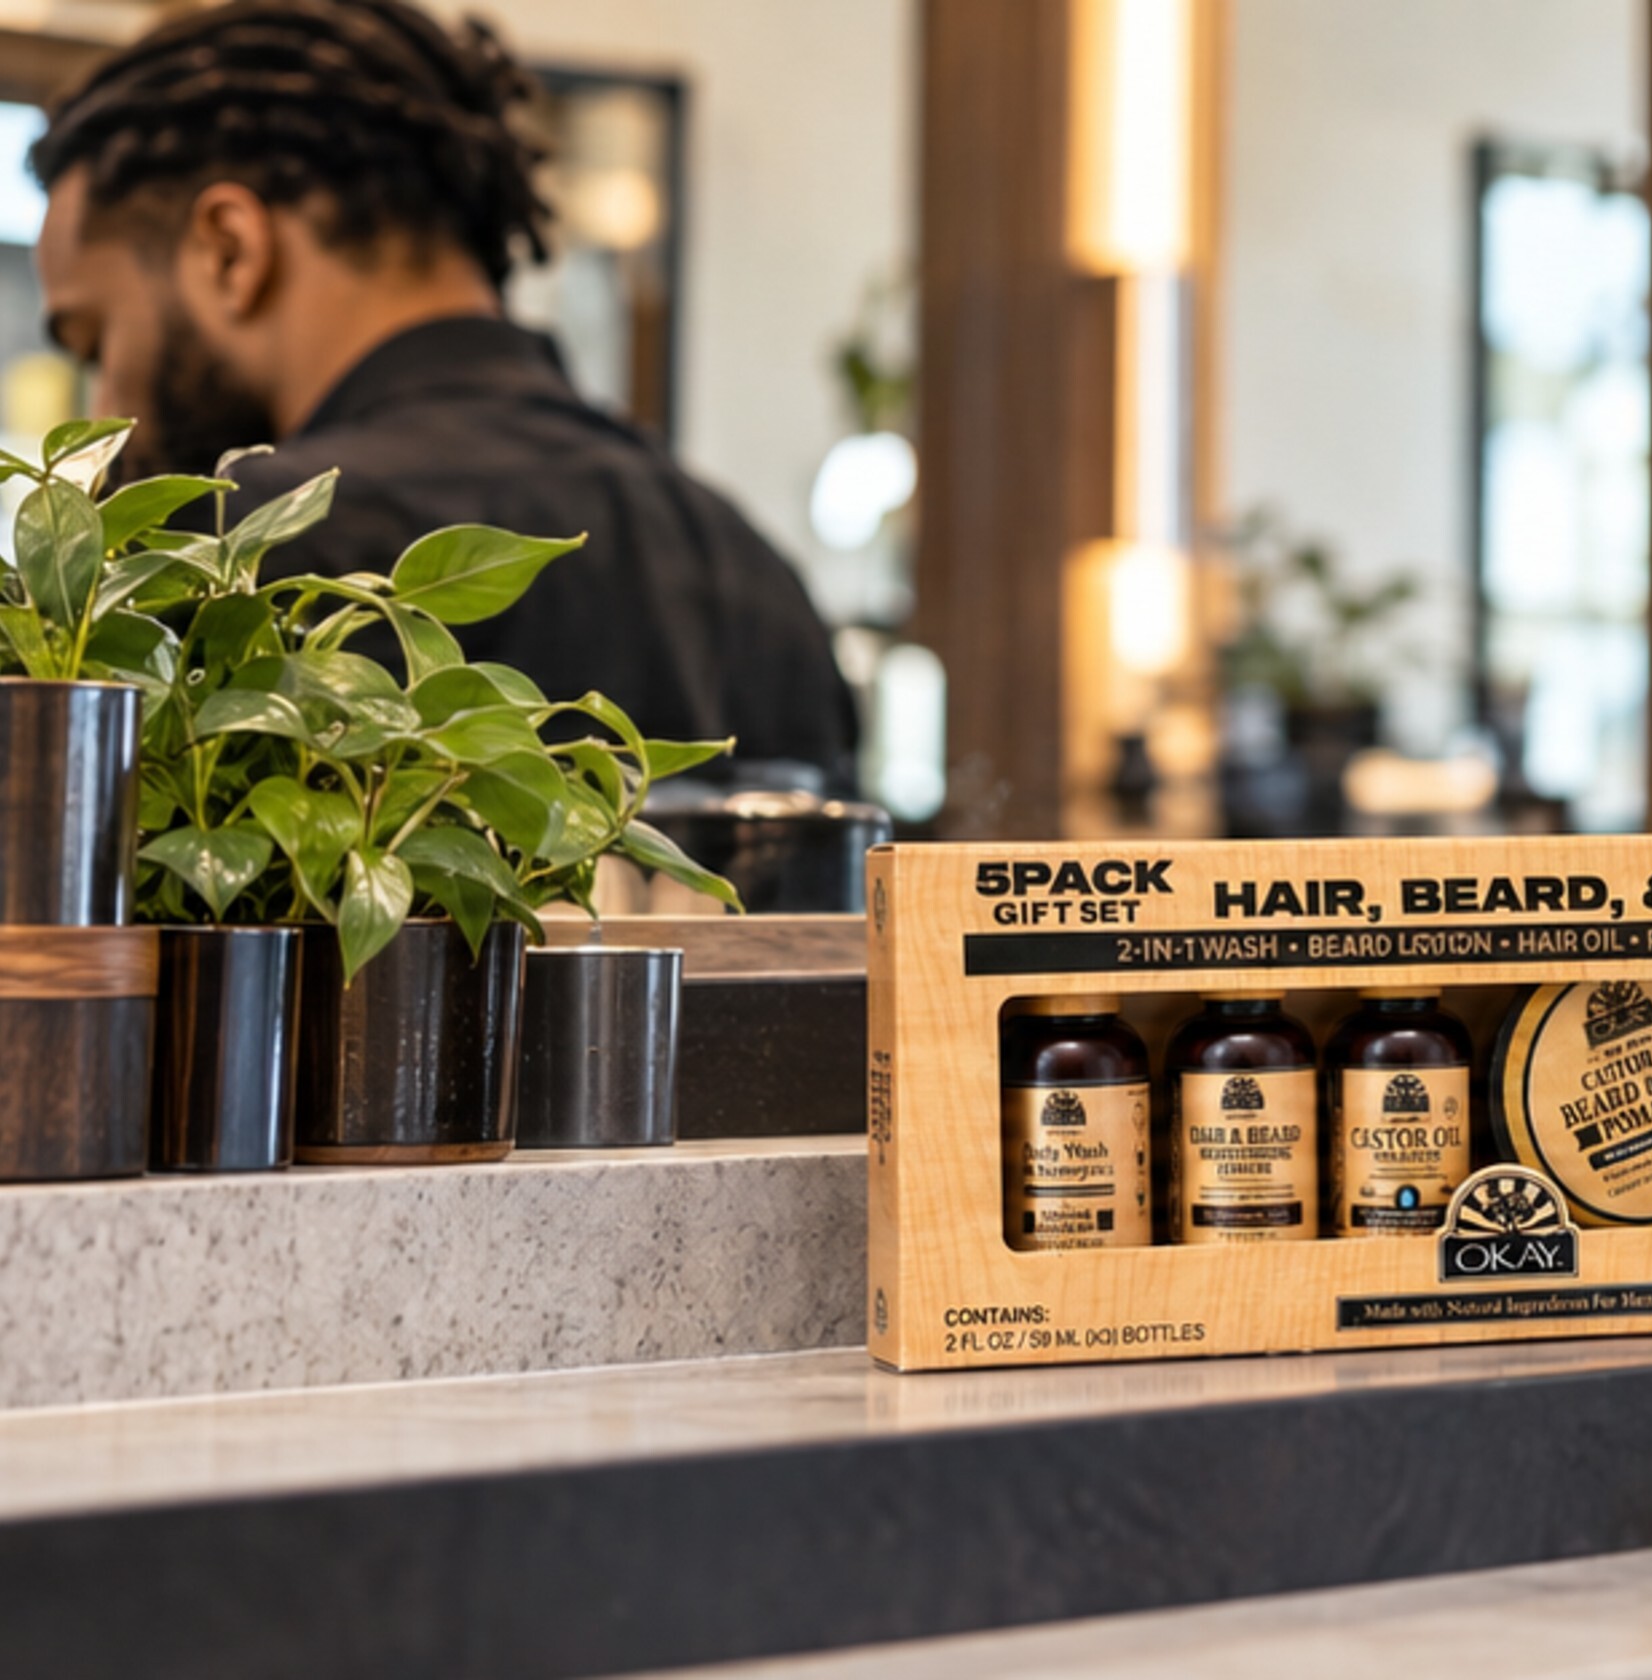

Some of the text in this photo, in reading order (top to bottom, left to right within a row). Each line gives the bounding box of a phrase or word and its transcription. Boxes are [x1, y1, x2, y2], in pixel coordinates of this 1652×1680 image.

[975, 859, 1174, 896] 5PACK
[993, 899, 1141, 926] GIFT SET
[1214, 879, 1382, 923] HAIR,
[1400, 875, 1625, 919] BEARD,
[1116, 937, 1195, 963] 2-IN-1
[1199, 935, 1279, 960] WASH
[1307, 934, 1392, 959] BEARD
[1517, 929, 1578, 953] HAIR
[1582, 928, 1624, 951] OIL
[1454, 1242, 1560, 1273] OKAY
[944, 1304, 1051, 1327] CONTAINS:
[944, 1332, 957, 1352] 2
[960, 1331, 984, 1351] FL
[988, 1330, 1015, 1350] OZ
[1016, 1328, 1027, 1348] /
[1122, 1322, 1206, 1344] BOTTLES
